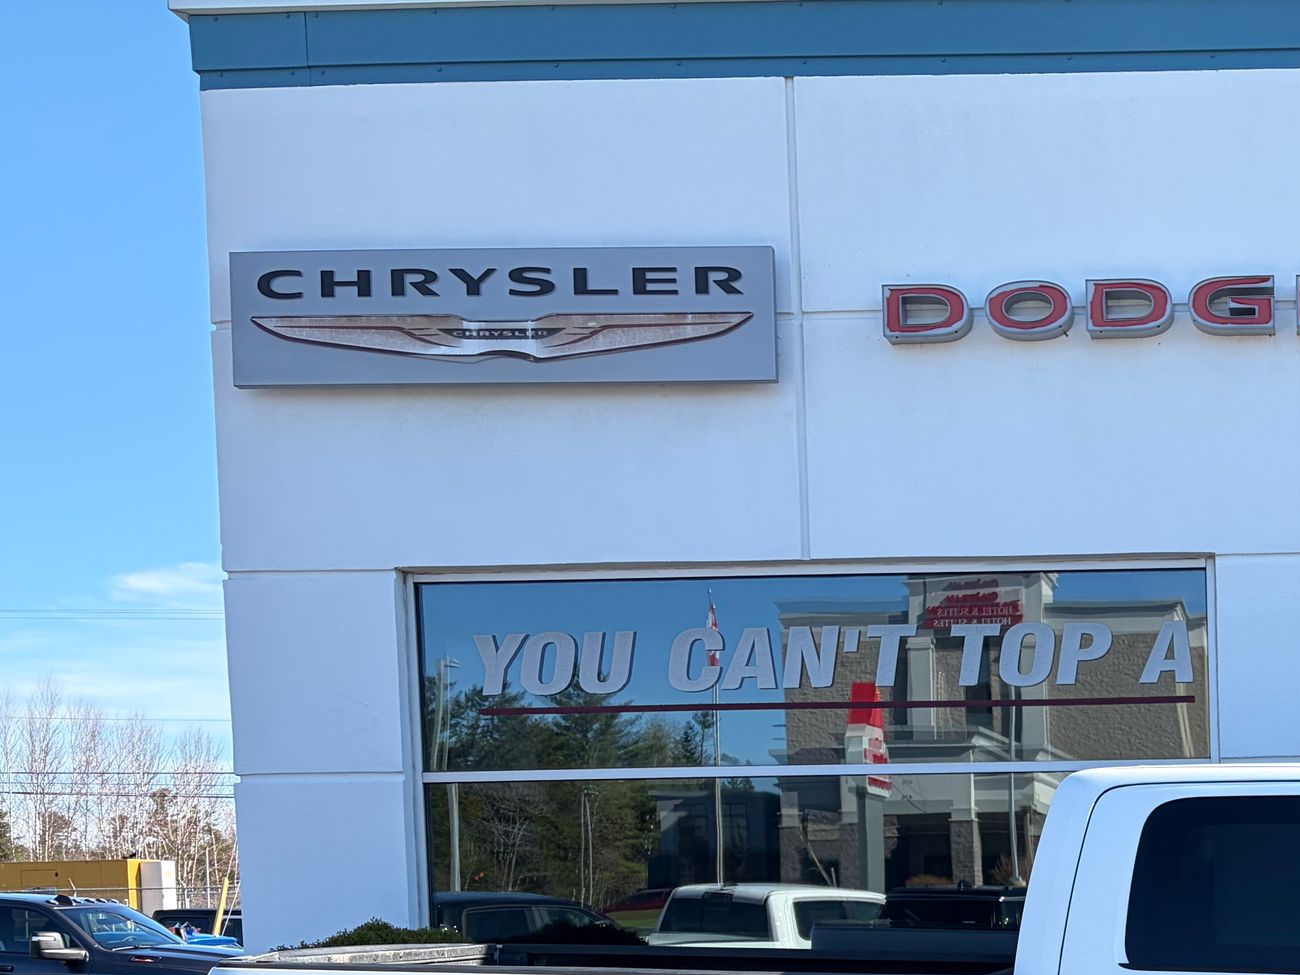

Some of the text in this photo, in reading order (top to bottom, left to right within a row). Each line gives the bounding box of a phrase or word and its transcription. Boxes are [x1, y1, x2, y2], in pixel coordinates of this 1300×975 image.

[256, 265, 744, 299] CHRYSLER
[452, 329, 549, 337] CHRYSLER
[473, 621, 1194, 697] YOU CAN'T TOP A
